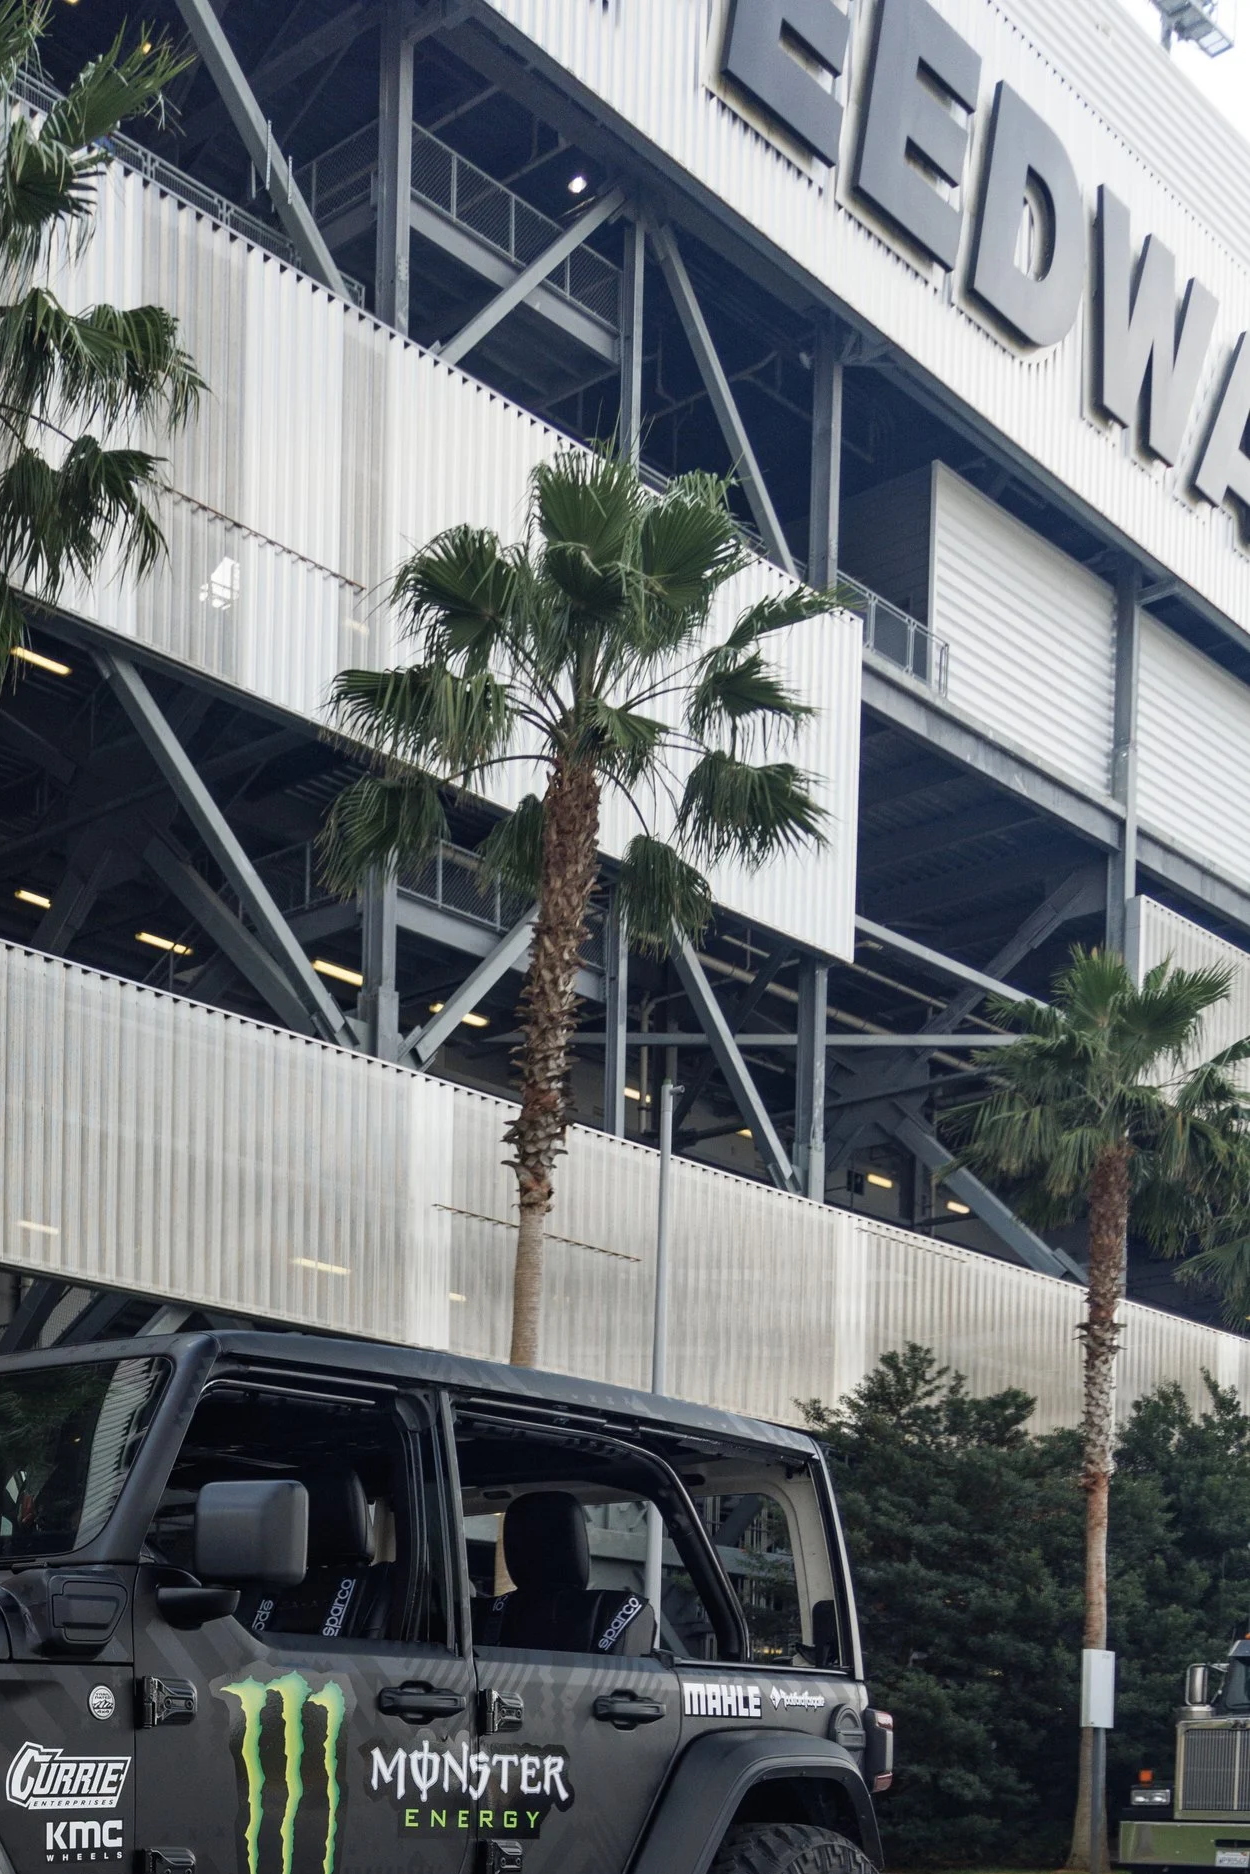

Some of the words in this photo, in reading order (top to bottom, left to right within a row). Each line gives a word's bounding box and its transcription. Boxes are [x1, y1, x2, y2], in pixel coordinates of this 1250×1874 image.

[322, 1578, 356, 1637] sparco
[598, 1596, 643, 1651] sparco
[682, 1682, 762, 1717] MAHLE
[11, 1748, 125, 1800] CURRIE
[370, 1740, 570, 1802] MONSTER
[33, 1799, 114, 1808] ENTERPRISES
[404, 1808, 540, 1829] ENERGY
[46, 1851, 123, 1862] WHEELS
